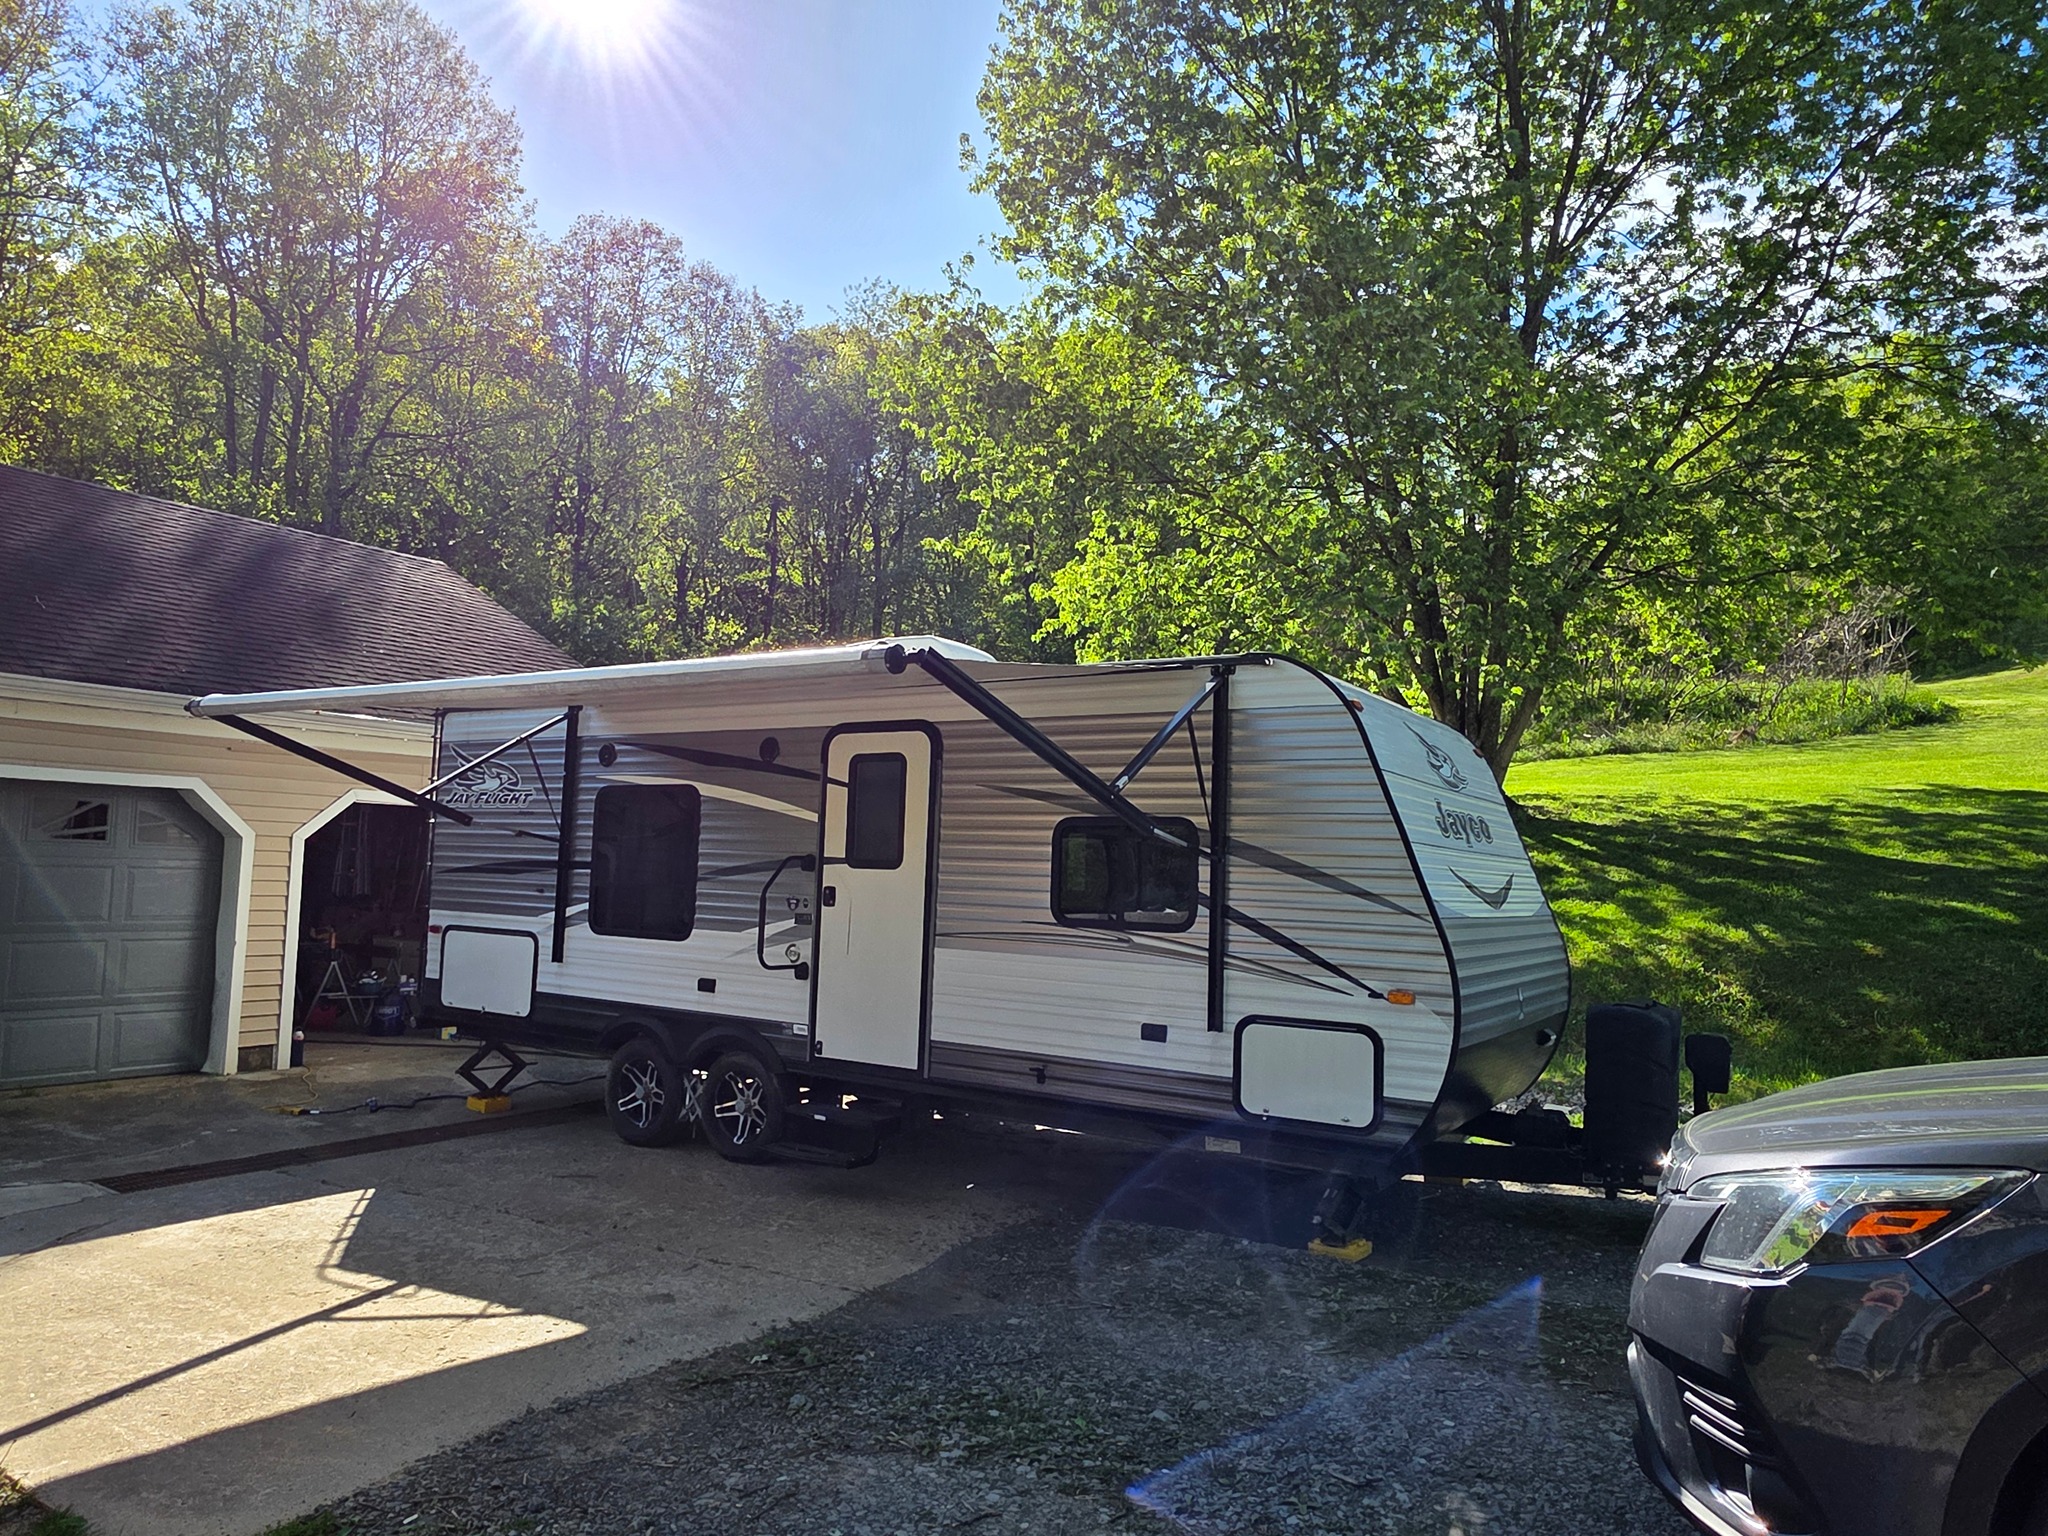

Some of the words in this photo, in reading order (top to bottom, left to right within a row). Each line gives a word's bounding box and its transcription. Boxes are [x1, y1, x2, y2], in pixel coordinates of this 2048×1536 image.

[445, 791, 475, 805] JAY
[474, 791, 534, 805] FLIGHT
[1434, 799, 1493, 847] Jayco
